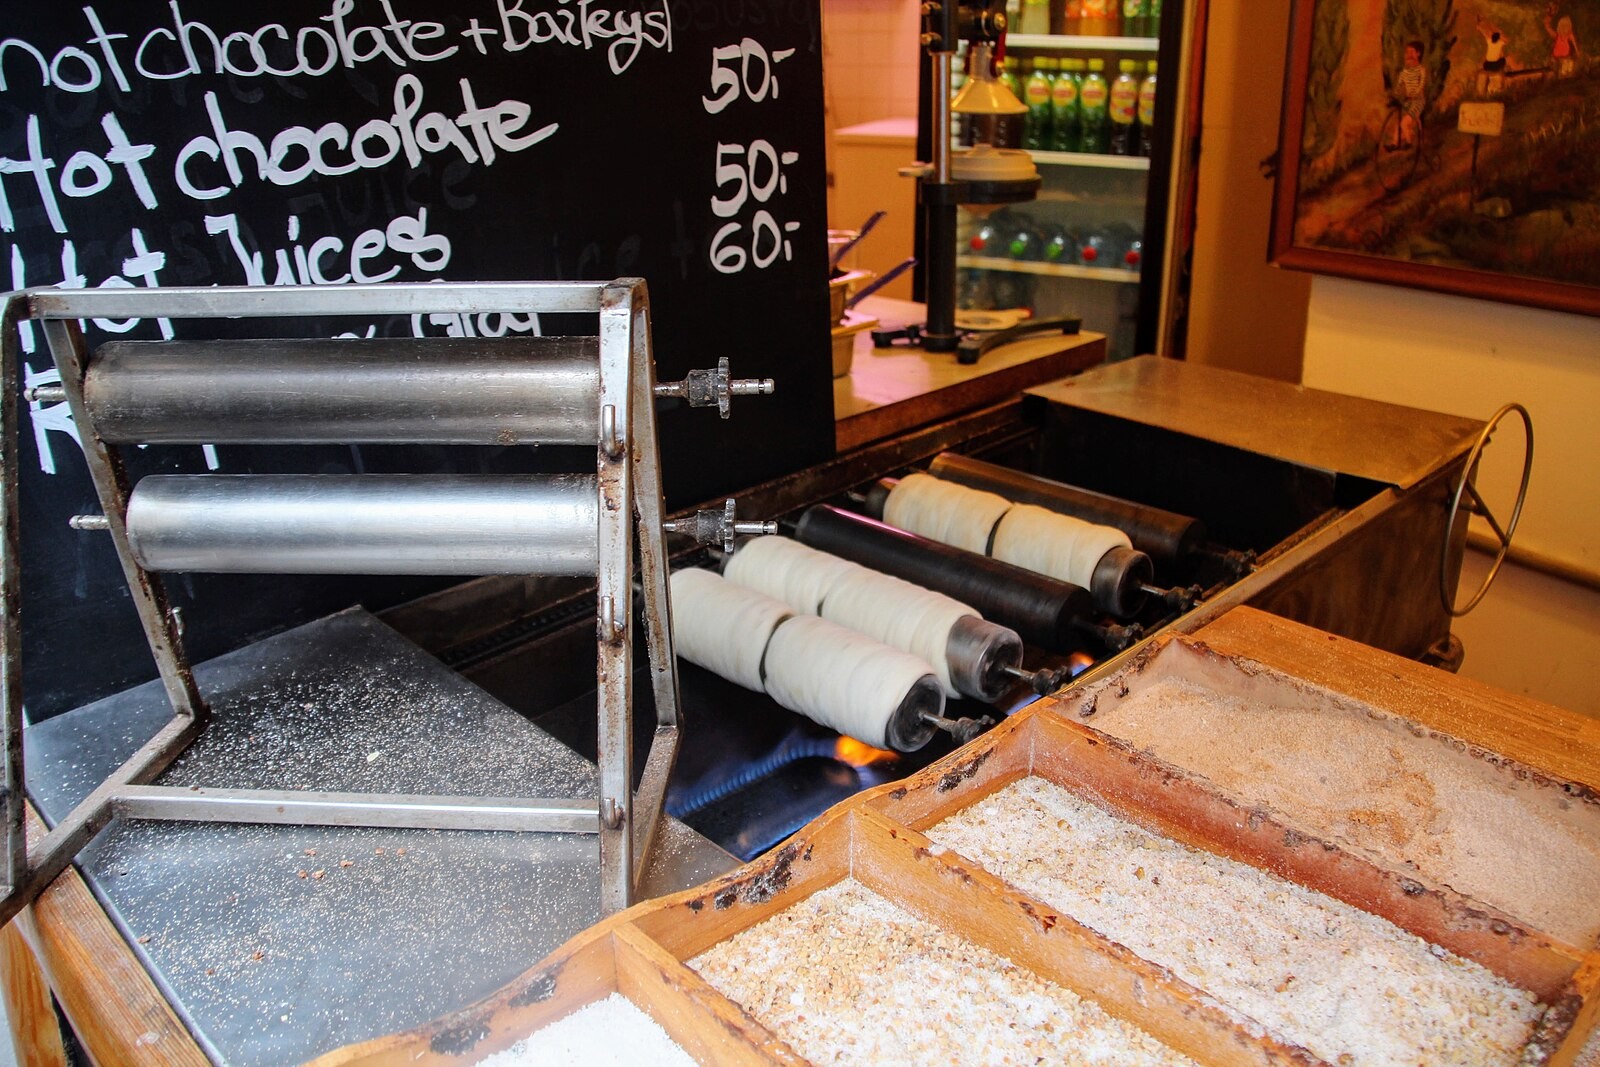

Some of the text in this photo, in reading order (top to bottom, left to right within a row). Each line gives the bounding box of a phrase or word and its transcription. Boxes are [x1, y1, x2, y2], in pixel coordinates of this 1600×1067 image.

[136, 0, 459, 79] chocolate
[0, 112, 158, 232] Hot
[175, 74, 559, 199] chocolate
[204, 206, 451, 286] Juices
